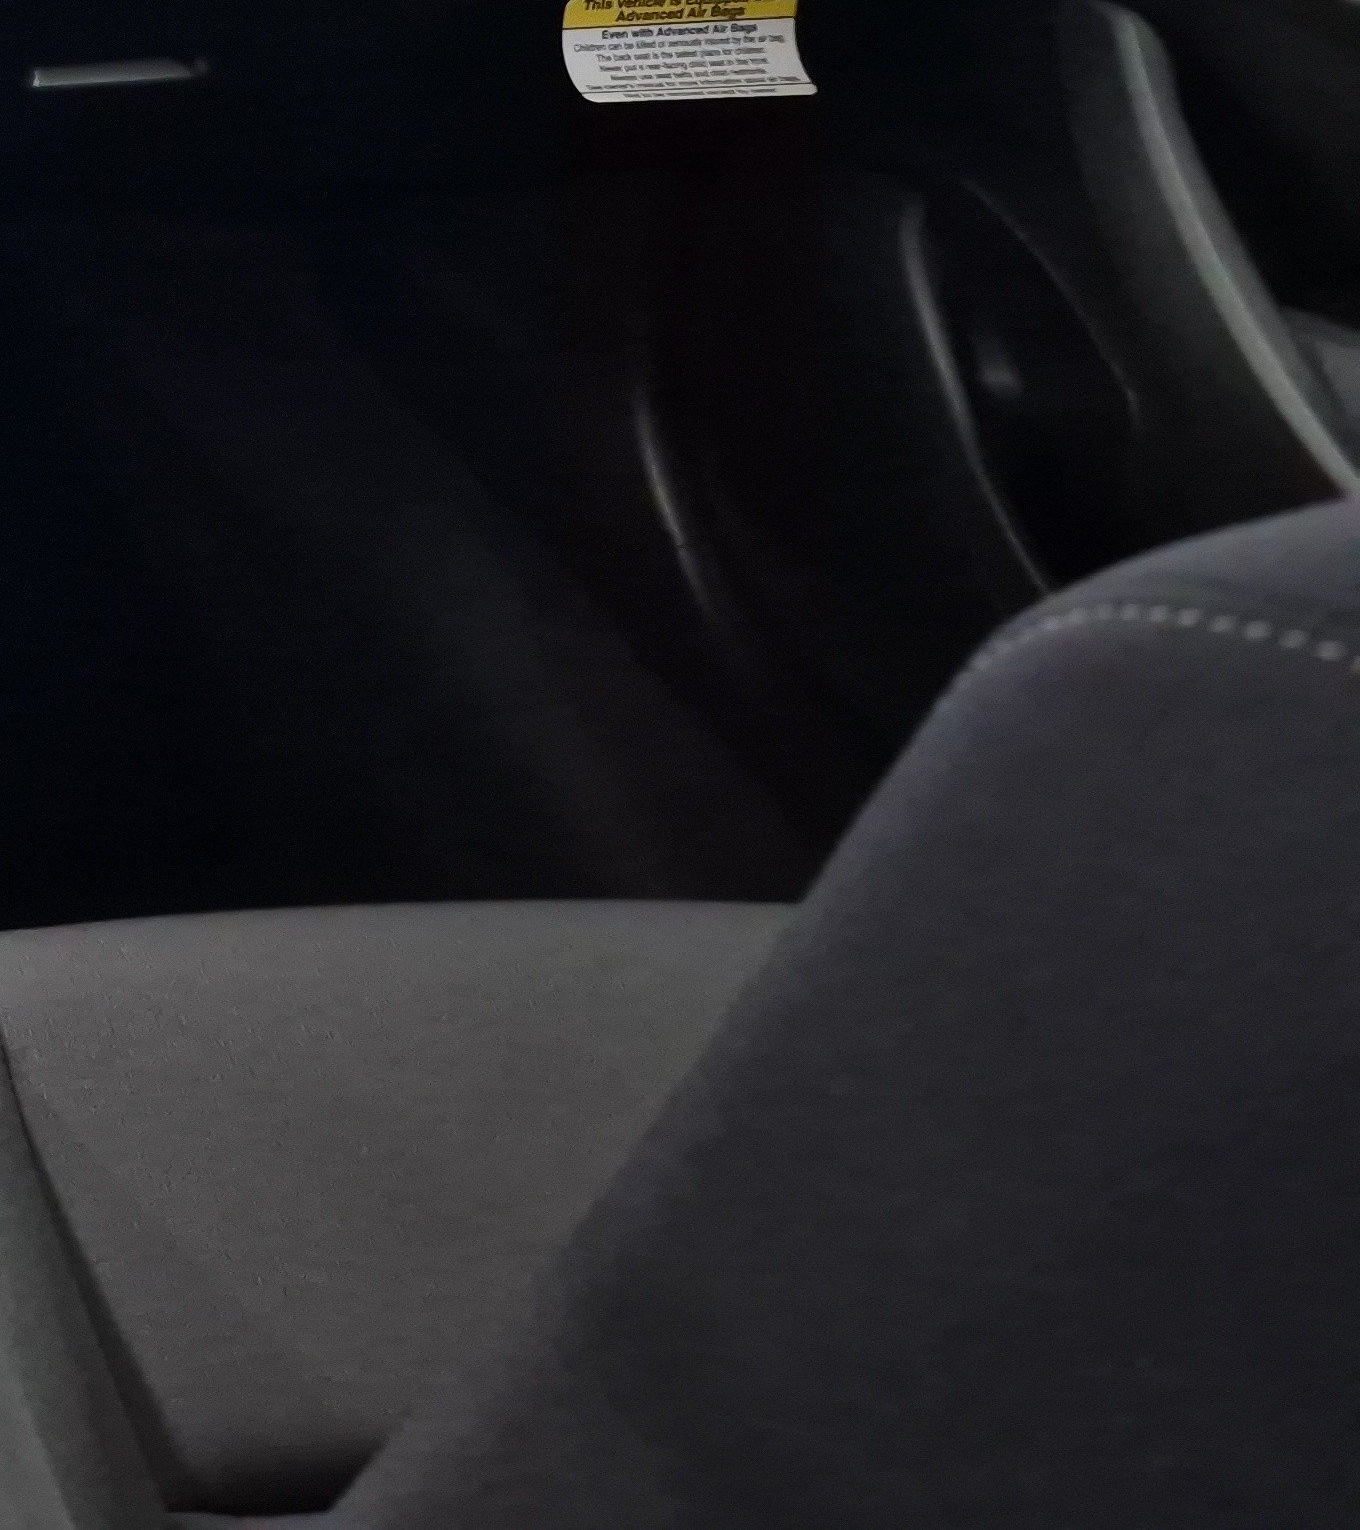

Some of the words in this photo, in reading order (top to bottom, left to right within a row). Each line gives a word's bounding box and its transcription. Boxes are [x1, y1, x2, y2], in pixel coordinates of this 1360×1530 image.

[583, 0, 613, 11] This
[614, 8, 685, 23] Advanced
[686, 7, 708, 18] Air
[601, 29, 629, 40] Even
[656, 25, 710, 37] Advanced
